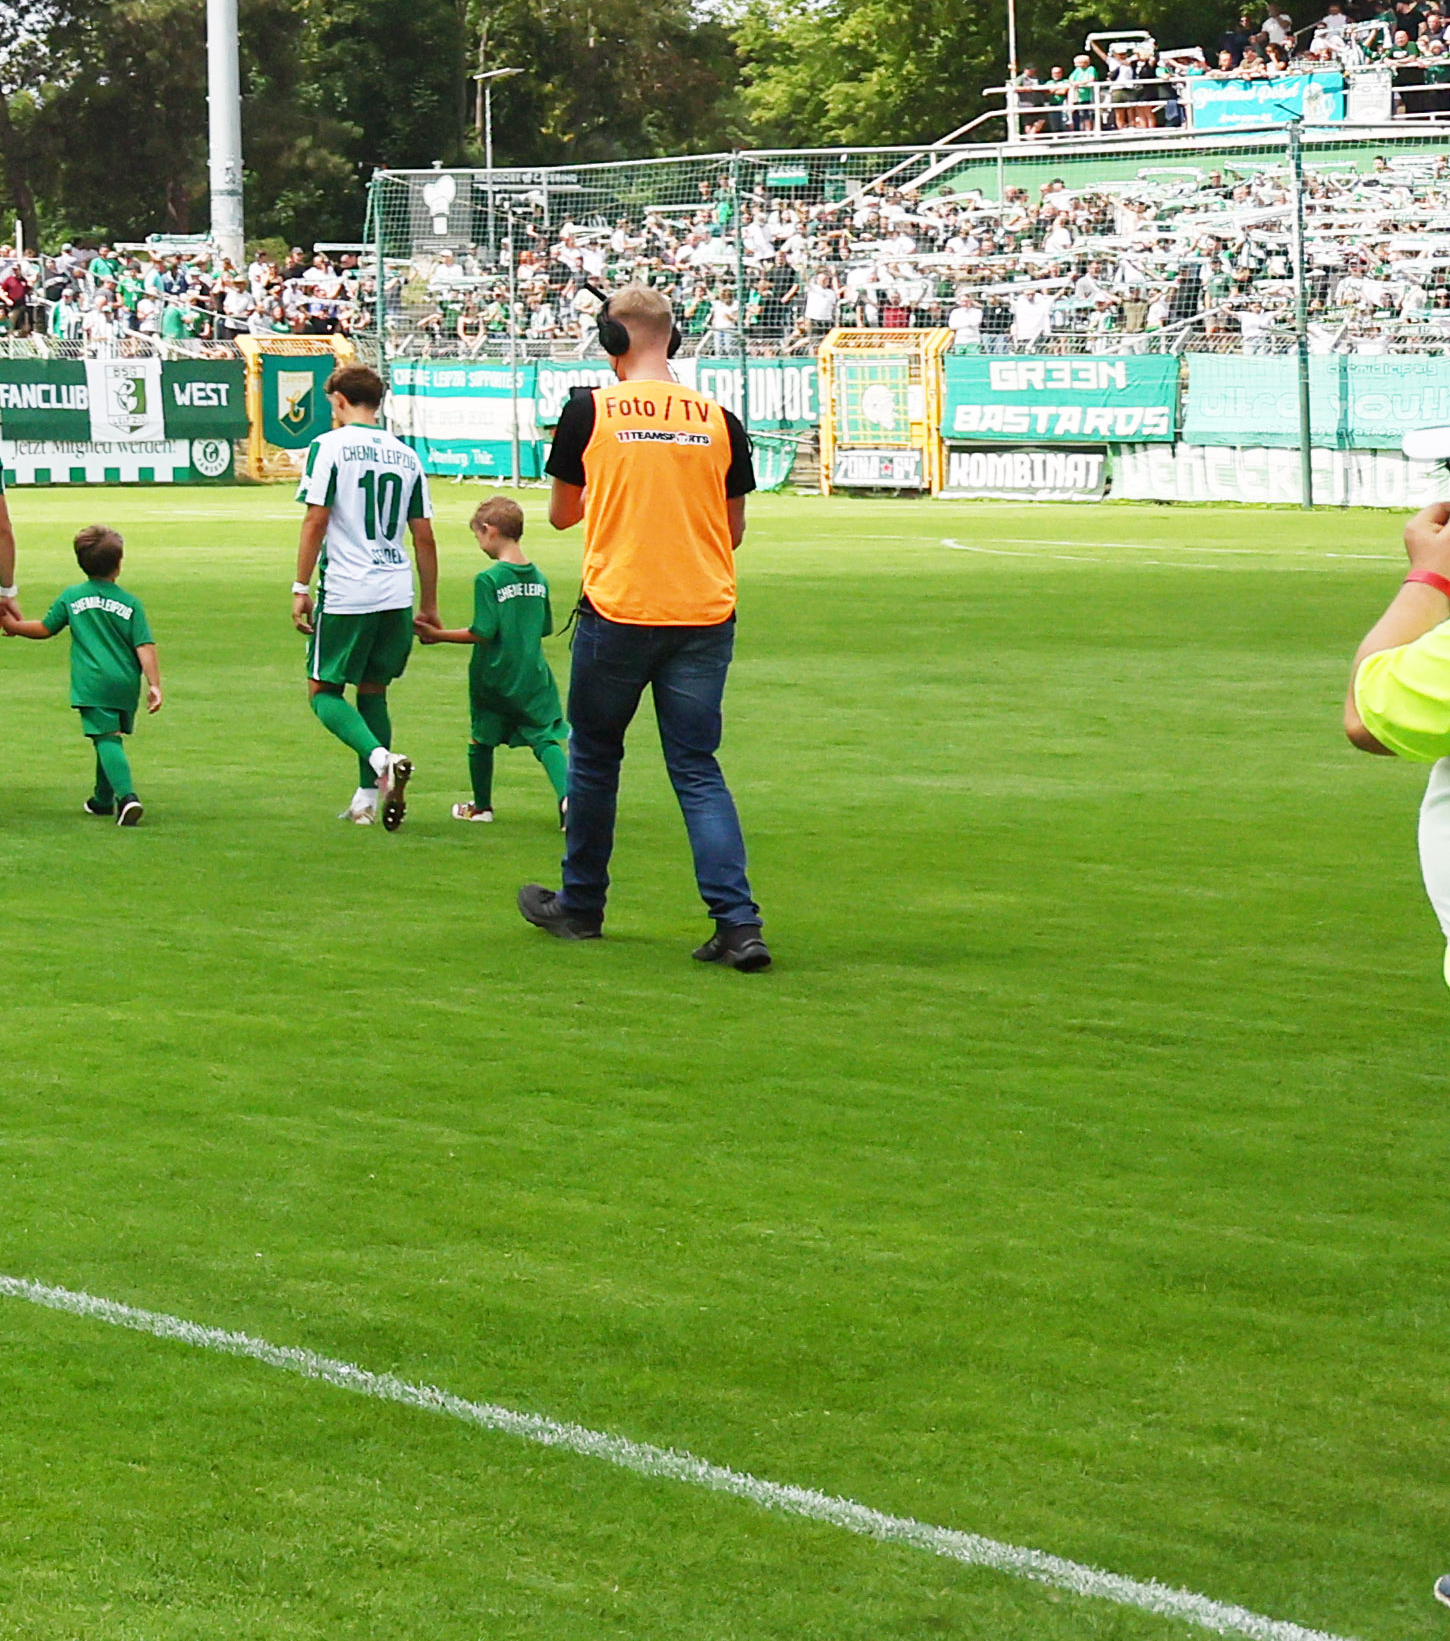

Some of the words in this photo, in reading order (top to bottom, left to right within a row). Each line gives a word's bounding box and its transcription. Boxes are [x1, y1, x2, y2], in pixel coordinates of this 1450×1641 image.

[0, 383, 89, 410] FANCLUB
[173, 382, 230, 406] WEST
[606, 395, 656, 419] Foto
[663, 395, 672, 421] /
[680, 398, 709, 423] TV
[953, 405, 1169, 436] BASTARDS
[617, 430, 711, 446] 11TEAMSPORTS
[342, 445, 380, 466] CHEMIE
[381, 447, 417, 472] LEIPZIG
[950, 452, 1104, 489] KOMBINAT
[358, 469, 403, 541] 10
[497, 582, 524, 604] CHEMIE
[71, 596, 101, 616] CHEMIE
[101, 595, 134, 621] LEIPZIG
